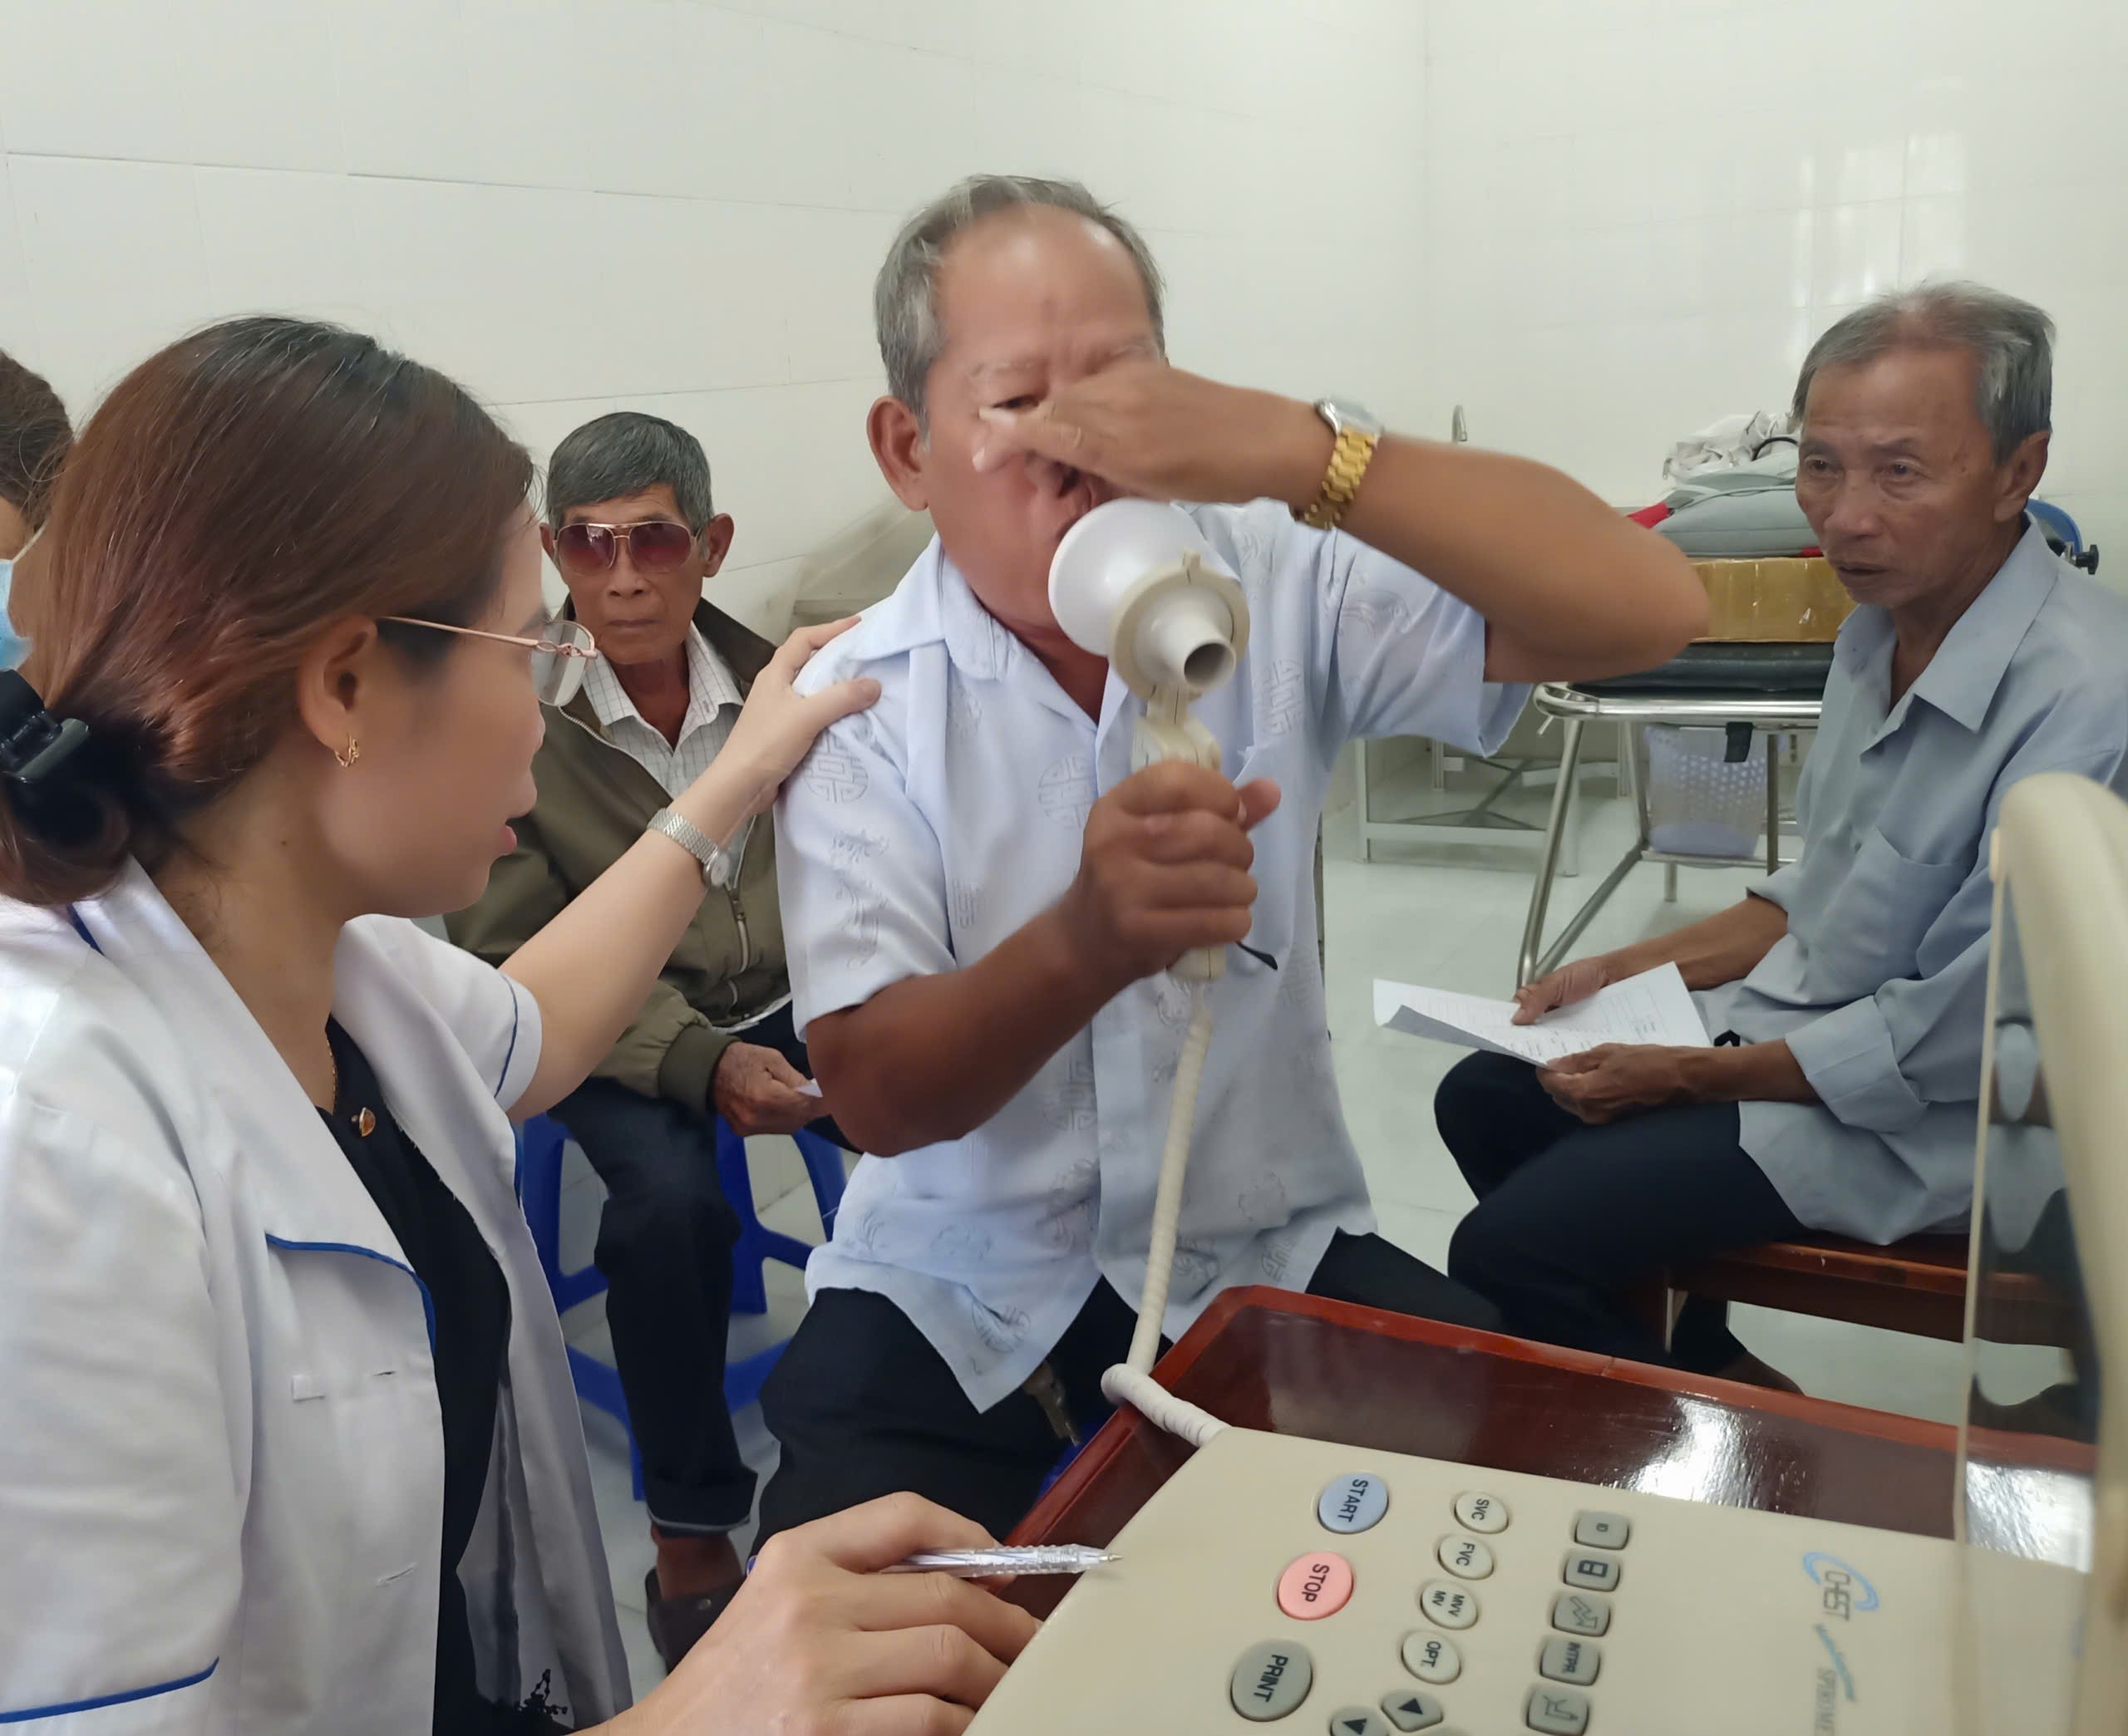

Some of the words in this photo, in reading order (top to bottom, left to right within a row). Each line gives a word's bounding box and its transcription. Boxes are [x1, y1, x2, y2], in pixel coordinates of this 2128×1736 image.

[1337, 1478, 1369, 1522] START
[1471, 1498, 1490, 1521] SVC
[1456, 1542, 1475, 1566] FVC
[1302, 1563, 1330, 1603] STOP
[1432, 1591, 1446, 1606] MV
[1448, 1594, 1465, 1617] MVV
[1254, 1654, 1288, 1703] PRINT
